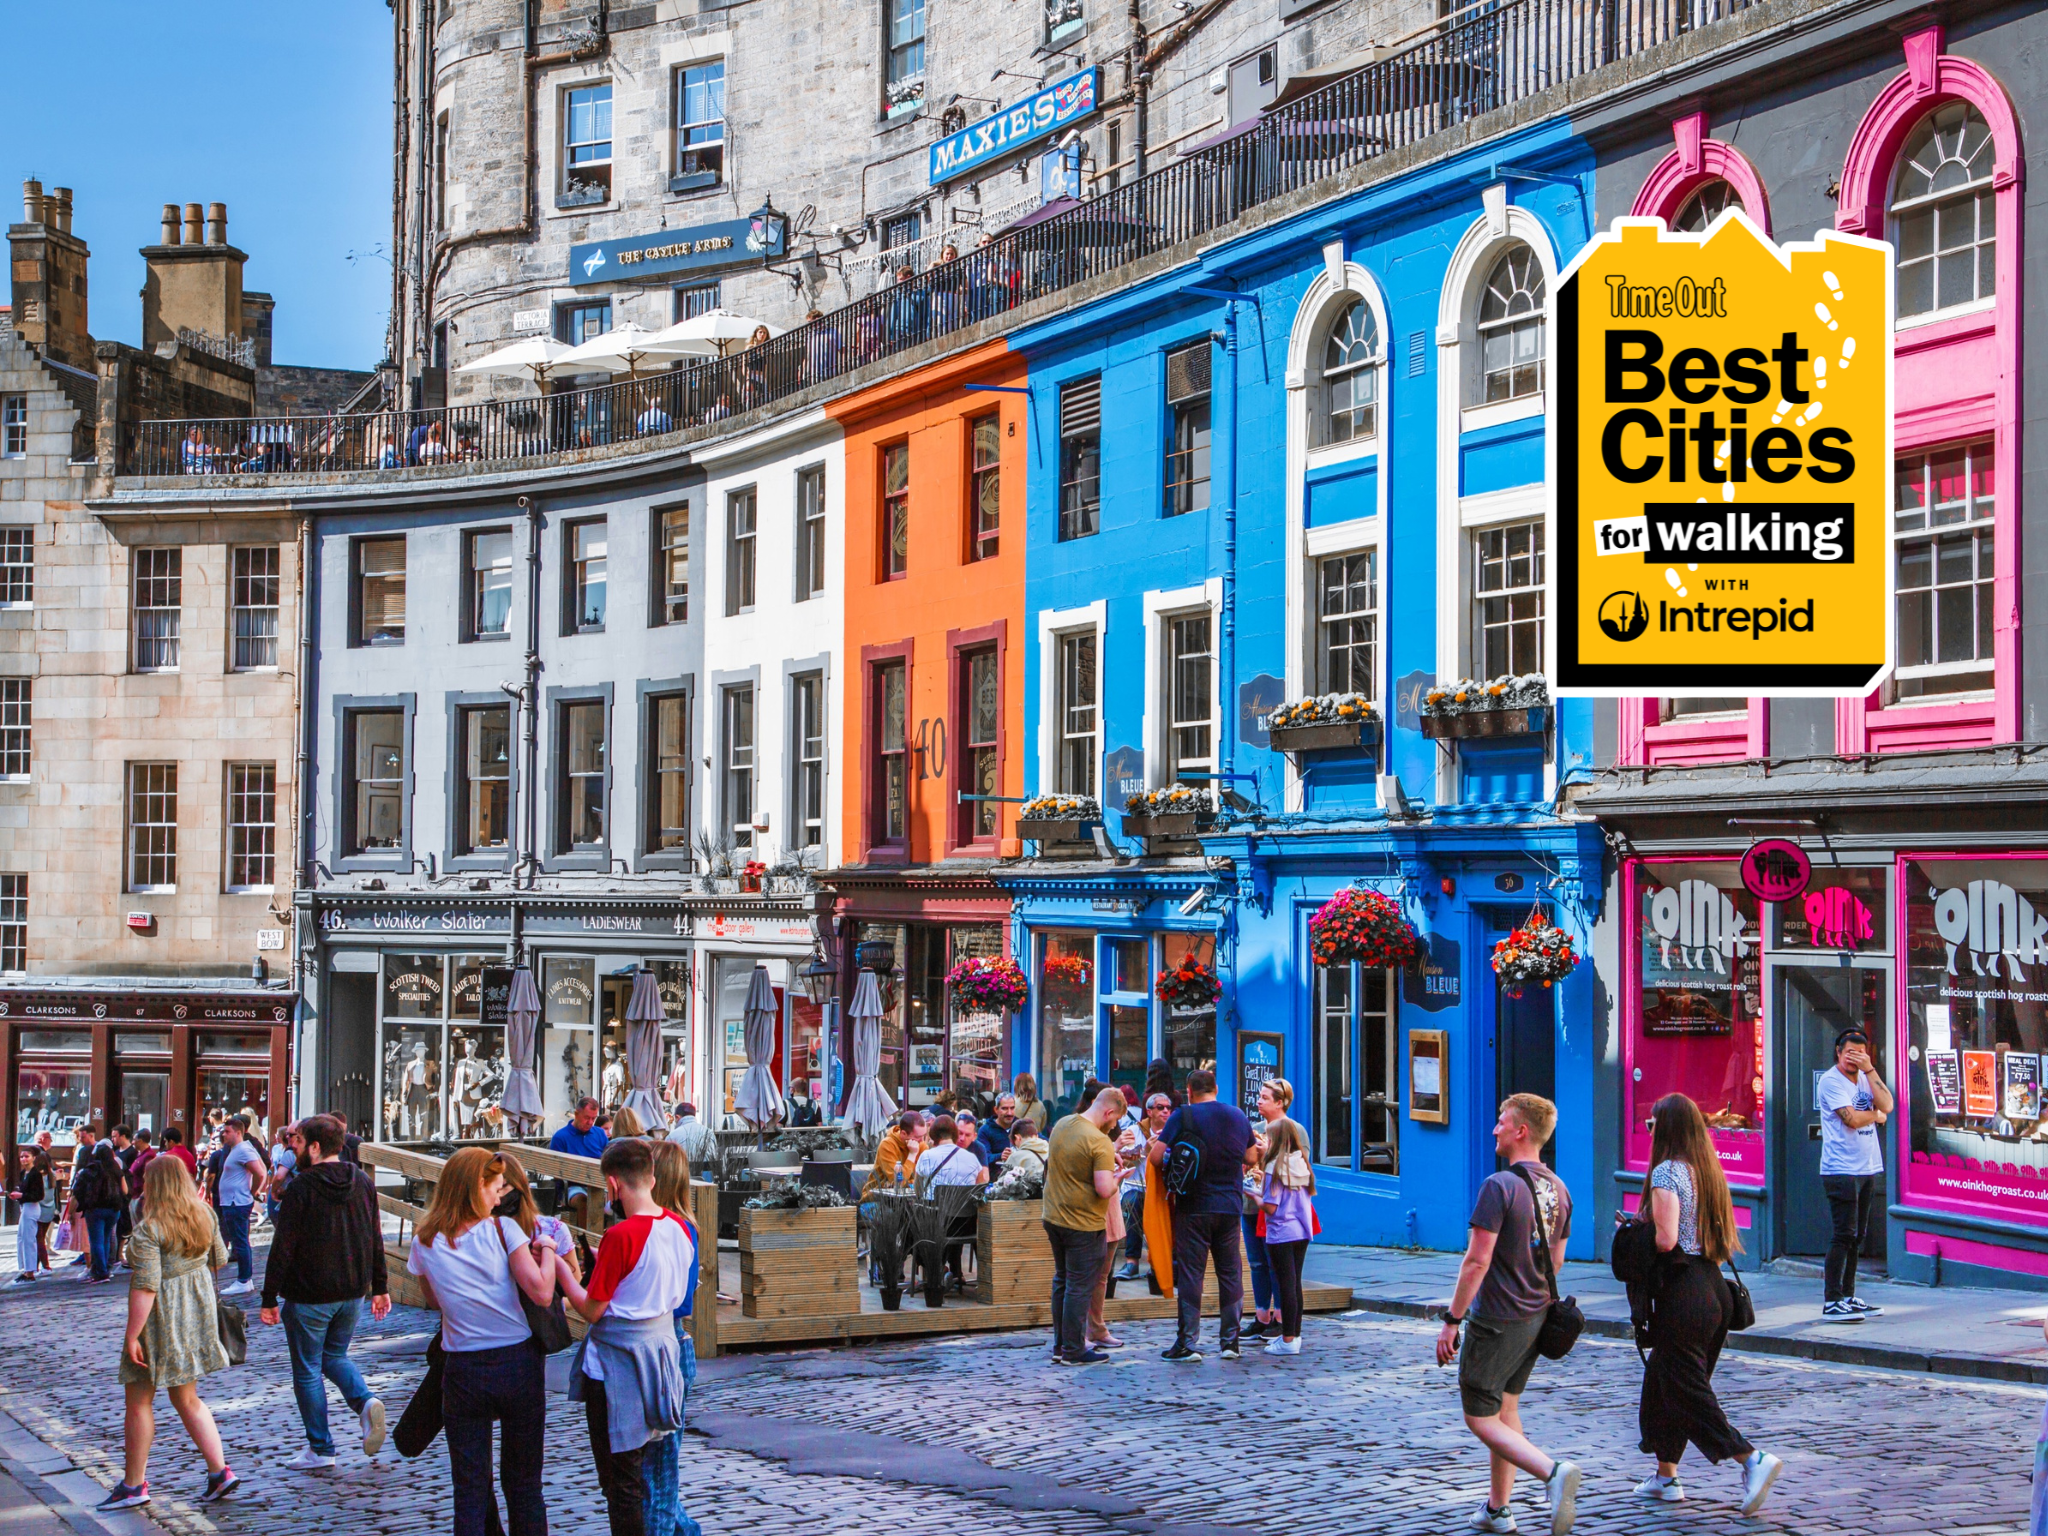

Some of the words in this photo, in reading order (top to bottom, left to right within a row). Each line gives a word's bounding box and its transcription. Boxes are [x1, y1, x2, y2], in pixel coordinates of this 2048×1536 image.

[934, 91, 1056, 176] MAXIES
[617, 249, 643, 265] THE
[645, 242, 691, 260] CASTLE
[694, 236, 733, 253] ARMS
[515, 310, 548, 321] VICTORIA
[517, 319, 547, 330] TERRACE
[913, 717, 946, 781] 40
[1121, 779, 1144, 794] BLEUE
[374, 911, 431, 930] Walker
[442, 910, 491, 930] Slater
[583, 915, 642, 932] LADIESWEAR
[1785, 921, 1808, 930] RDER
[260, 931, 282, 939] WEST
[739, 920, 755, 937] gallery
[261, 940, 280, 948] BOW
[389, 974, 420, 993] SCOTTISH
[420, 974, 441, 994] TWEED
[451, 978, 468, 997] MADE
[468, 975, 478, 985] TO
[547, 980, 564, 1000] LADIES
[563, 977, 593, 1001] ACCESSORIES
[1425, 976, 1459, 995] BLEUE
[1655, 979, 1680, 988] delicious
[1680, 981, 1703, 989] scottish
[1704, 981, 1716, 992] hog
[1716, 983, 1733, 991] roast
[1733, 983, 1747, 991] rolls
[398, 992, 431, 1001] SPECIALITIES
[465, 994, 481, 1002] TAILO
[558, 997, 582, 1006] KNITWEAR
[1940, 987, 1973, 998] delicious
[1975, 989, 2006, 1000] scottish
[2007, 990, 2024, 1003] hog
[25, 1006, 77, 1015] CLARKSONS
[136, 1008, 145, 1016] 87
[205, 1009, 257, 1018] CLARKSONS
[966, 1038, 991, 1052] CONTEXT
[1249, 1057, 1271, 1065] MENU
[2008, 1057, 2022, 1065] MEAL
[2023, 1058, 2037, 1066] DEAL
[1245, 1064, 1260, 1081] Great
[1260, 1066, 1275, 1082] Value
[1246, 1080, 1263, 1092] LUN
[1938, 1177, 2048, 1201] www.oinkhogroast.co.uk
